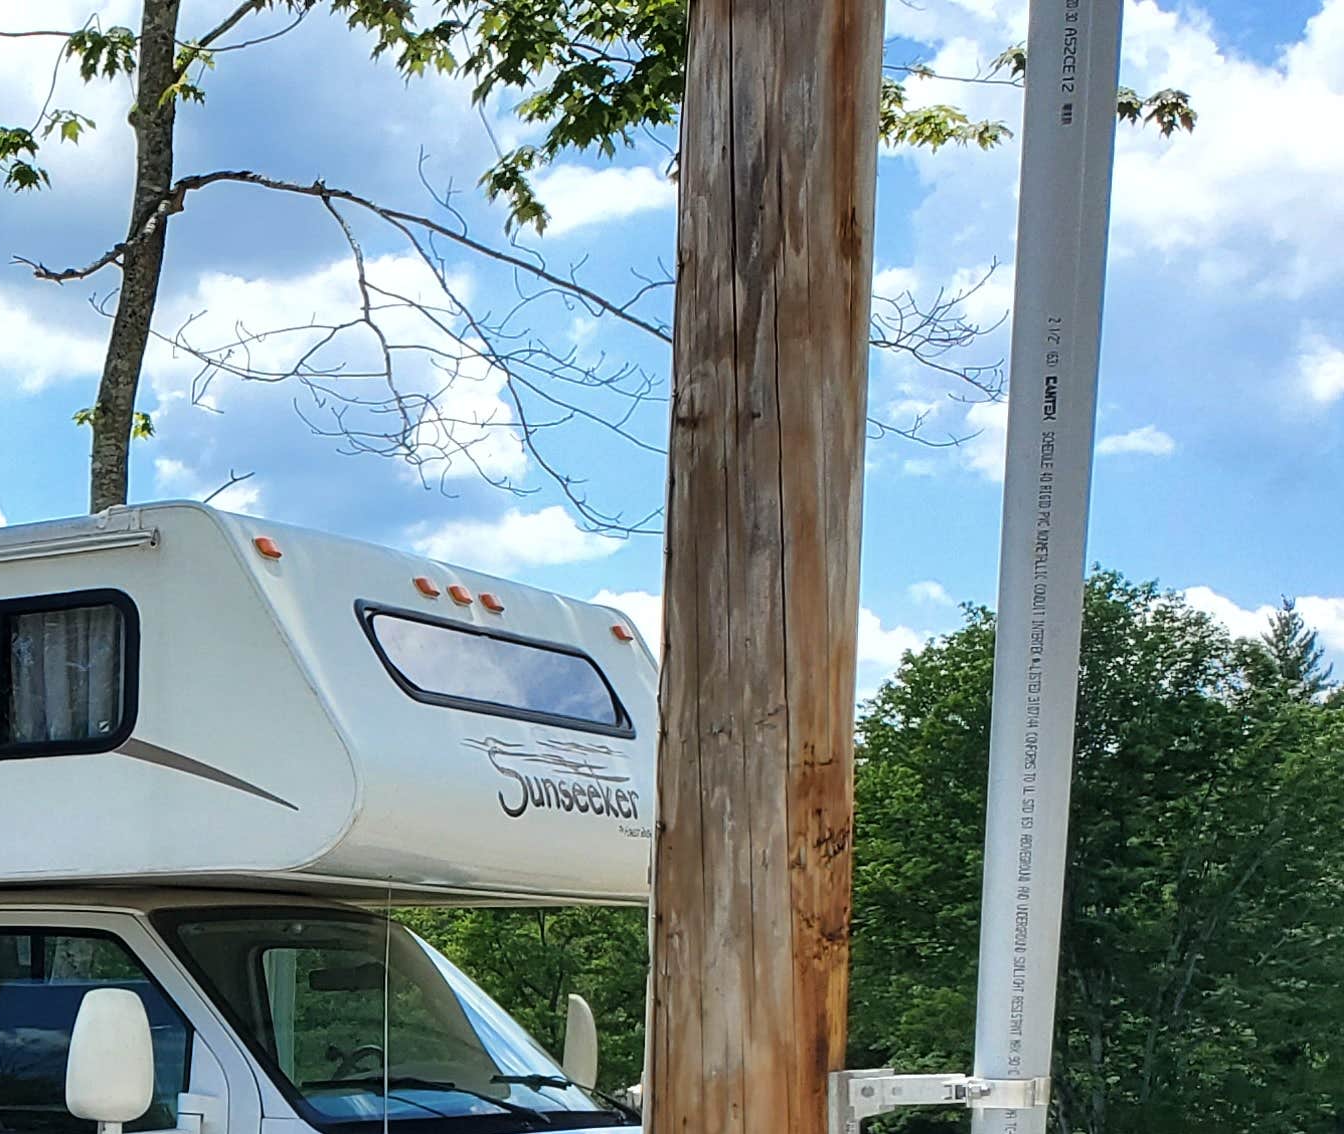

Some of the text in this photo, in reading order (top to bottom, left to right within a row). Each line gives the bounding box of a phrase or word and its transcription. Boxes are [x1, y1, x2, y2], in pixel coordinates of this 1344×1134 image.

[1062, 28, 1077, 92] A52CE12
[1044, 376, 1057, 421] CANTEX
[1041, 432, 1054, 468] SCHEDULE
[1040, 473, 1053, 482] 40
[1039, 486, 1052, 508] RIGID
[1038, 512, 1050, 526] PVC
[1034, 530, 1049, 579] NONMETALLIC
[1032, 584, 1047, 615] CONDUIT
[1031, 621, 1044, 655] INTERTEK
[1025, 732, 1038, 769] CONFORMS
[489, 749, 640, 819] Sunseeker
[1023, 786, 1035, 795] UL
[1024, 773, 1036, 782] TO
[1022, 799, 1034, 813] STD
[1018, 834, 1032, 881] ABOVEGROUND
[1017, 887, 1030, 900] AND
[1014, 904, 1029, 953] UNDERGROUND
[1013, 957, 1026, 992] SUNLIGHT
[1010, 996, 1024, 1036] RESISTANT
